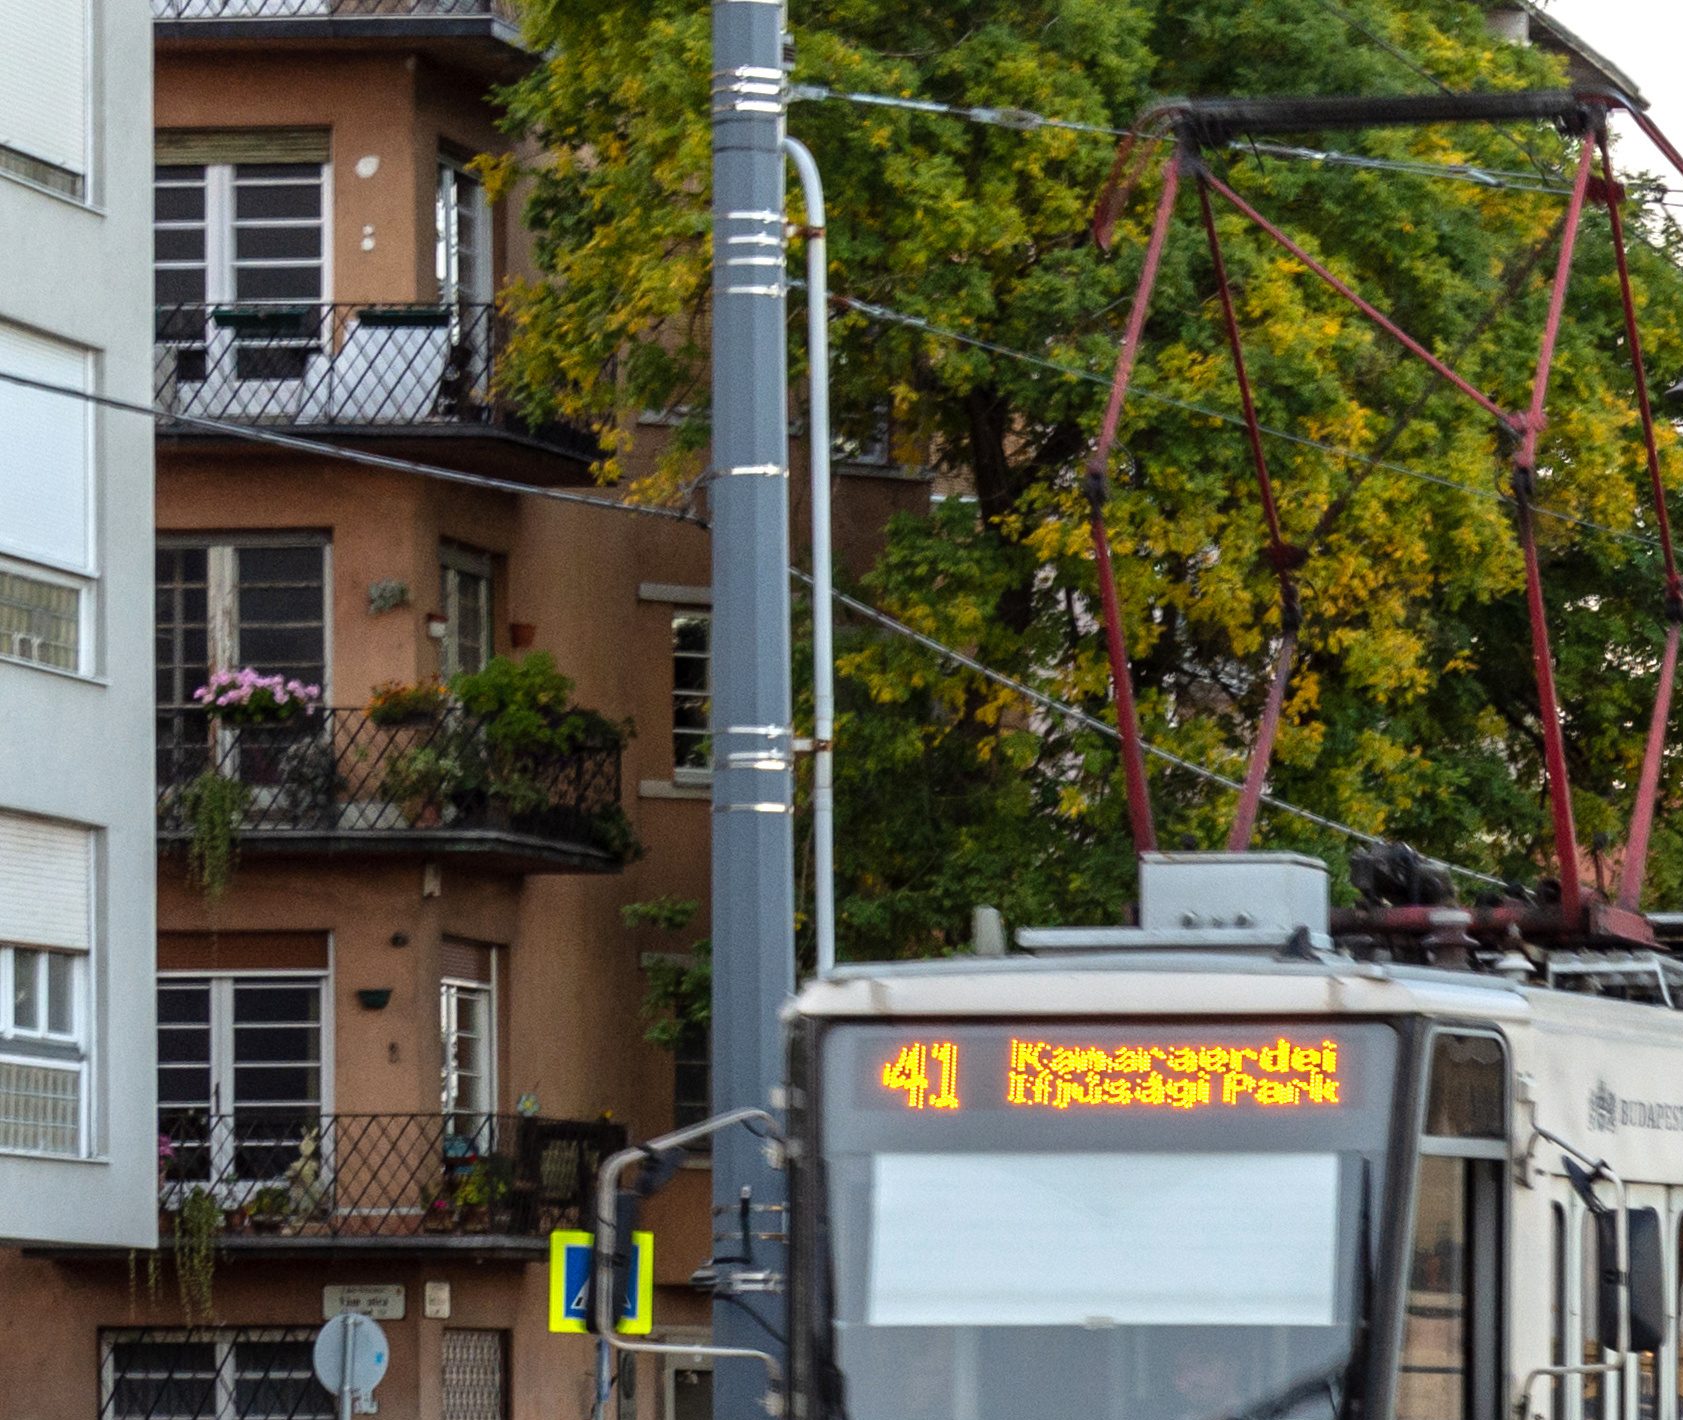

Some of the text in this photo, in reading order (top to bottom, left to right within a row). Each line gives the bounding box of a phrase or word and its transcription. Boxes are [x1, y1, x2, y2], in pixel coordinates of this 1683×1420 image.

[1009, 1038, 1338, 1073] Kamaraerdei
[881, 1042, 960, 1109] 41
[1008, 1071, 1340, 1108] Ifjúsági Park
